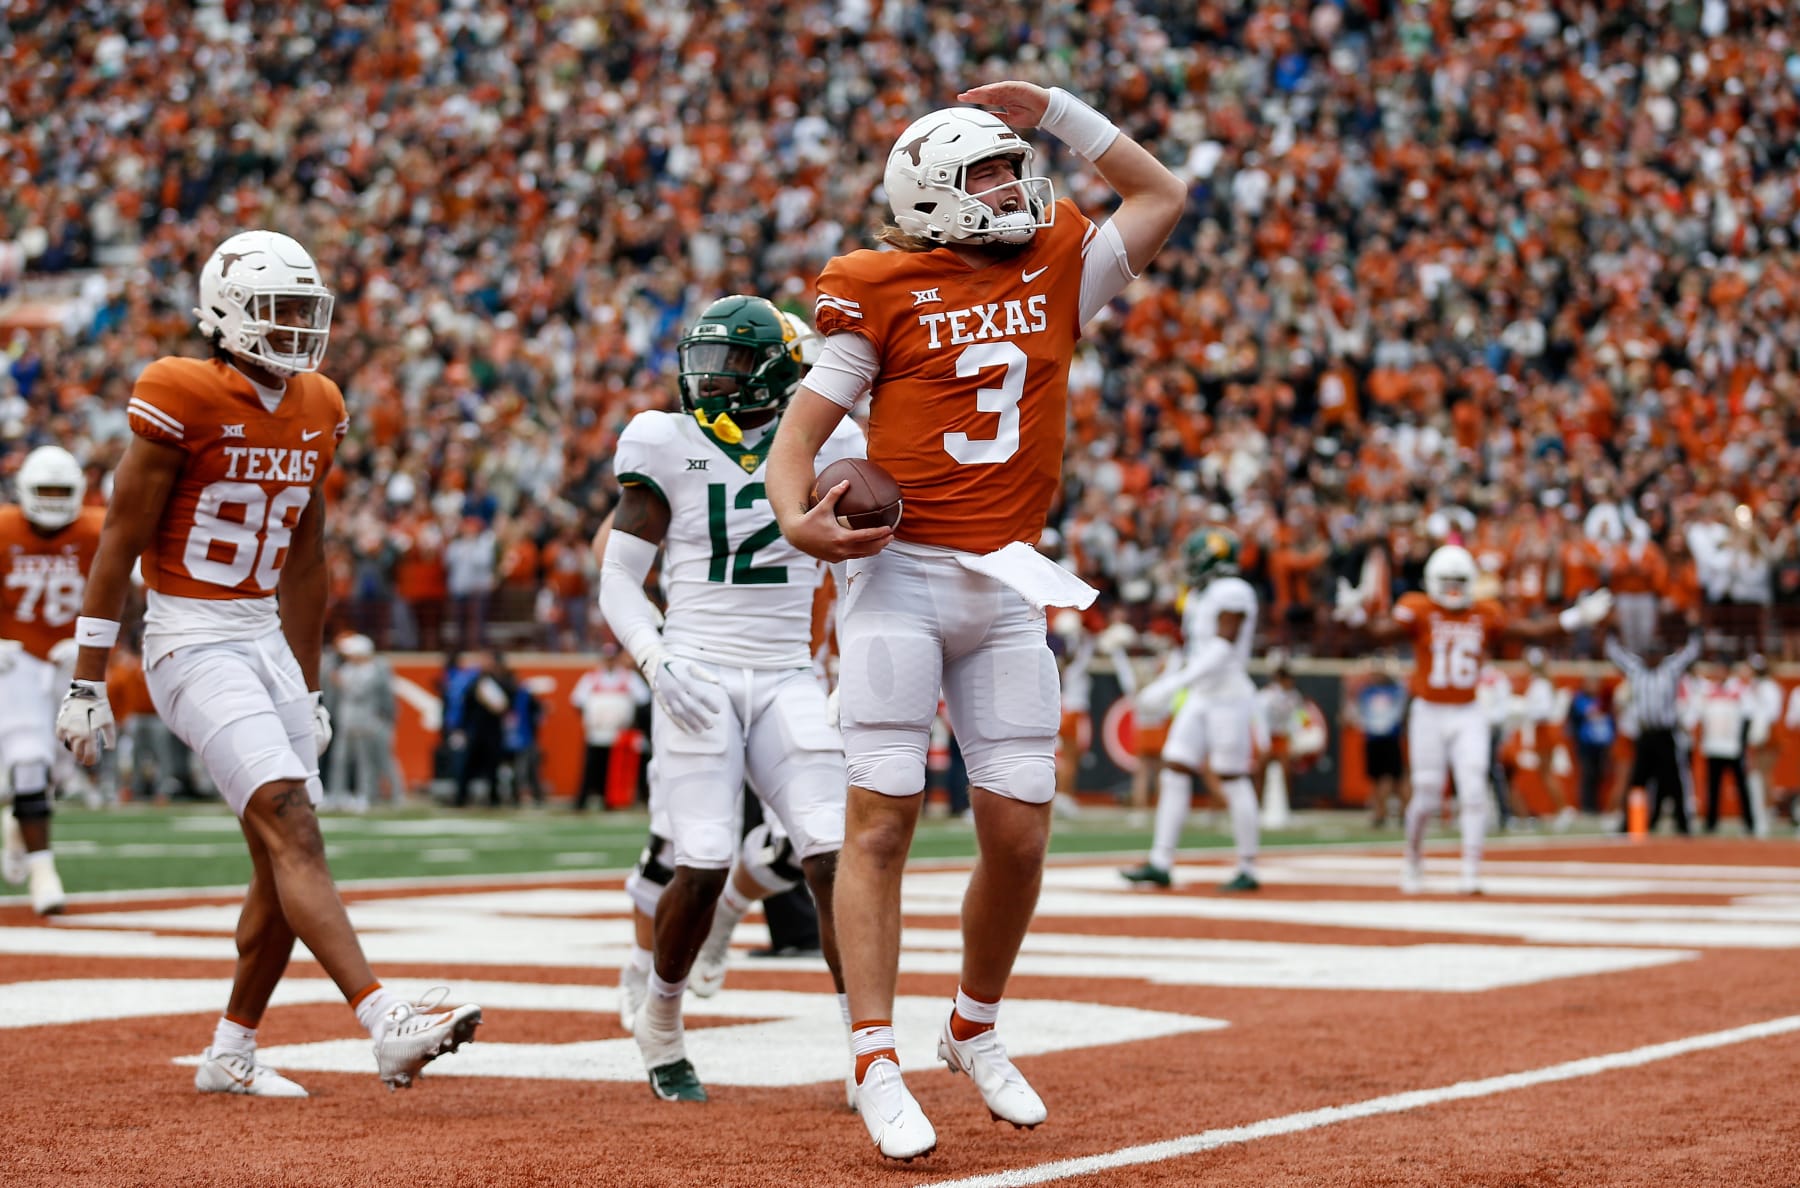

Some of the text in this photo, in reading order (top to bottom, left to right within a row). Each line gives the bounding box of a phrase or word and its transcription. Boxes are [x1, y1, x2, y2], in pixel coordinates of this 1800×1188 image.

[919, 295, 1047, 350] TEXAS
[944, 341, 1028, 464] 3
[225, 448, 318, 481] TEXAS
[184, 482, 311, 590] 88
[708, 483, 788, 584] 12
[6, 574, 84, 625] 78
[1430, 638, 1481, 689] 16
